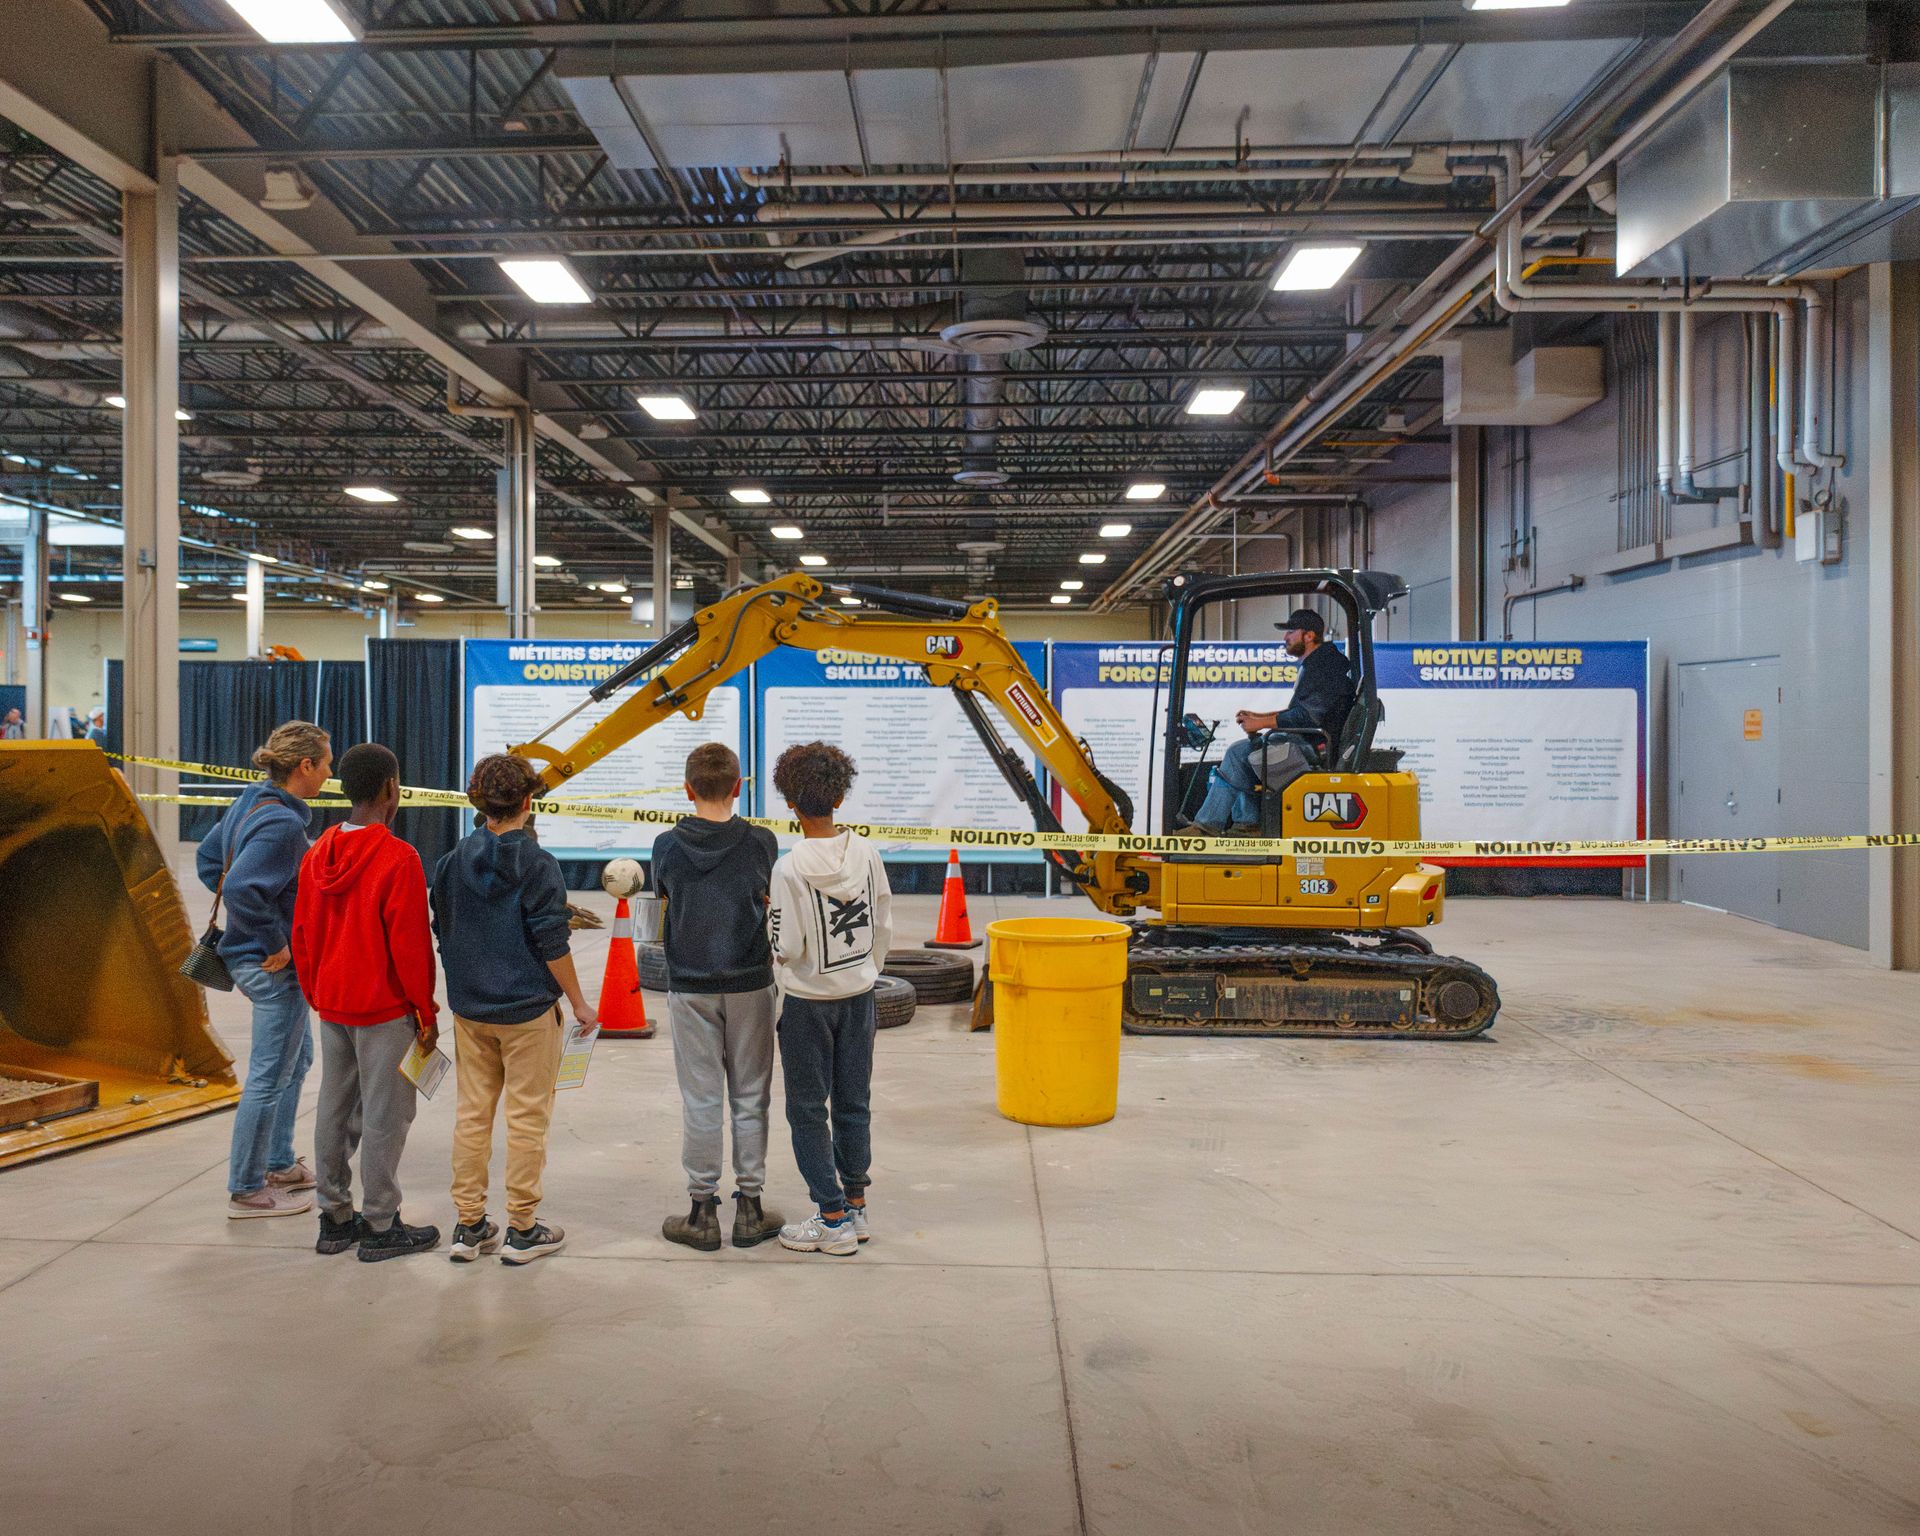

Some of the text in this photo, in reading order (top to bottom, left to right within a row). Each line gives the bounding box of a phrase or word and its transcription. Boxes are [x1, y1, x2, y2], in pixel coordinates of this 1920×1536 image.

[509, 644, 586, 661] MÉTIERS
[926, 636, 955, 654] CAT
[1188, 646, 1299, 662] SPÉCIALISÉS
[1412, 649, 1583, 665] MOTIVE POWER
[825, 666, 900, 680] SKILLED
[1187, 666, 1299, 682] MOTRICES
[1420, 667, 1575, 681] SKILLED TRADES
[1304, 793, 1352, 822] CAT
[950, 829, 1035, 846] CAUTION
[1118, 836, 1207, 852] CAUTION
[1214, 839, 1281, 847] 1-800-RENT-CAT
[1865, 834, 1920, 847] TION
[1293, 839, 1386, 855] CAUTION
[1474, 841, 1572, 855] CAUTION
[1299, 878, 1329, 895] 303
